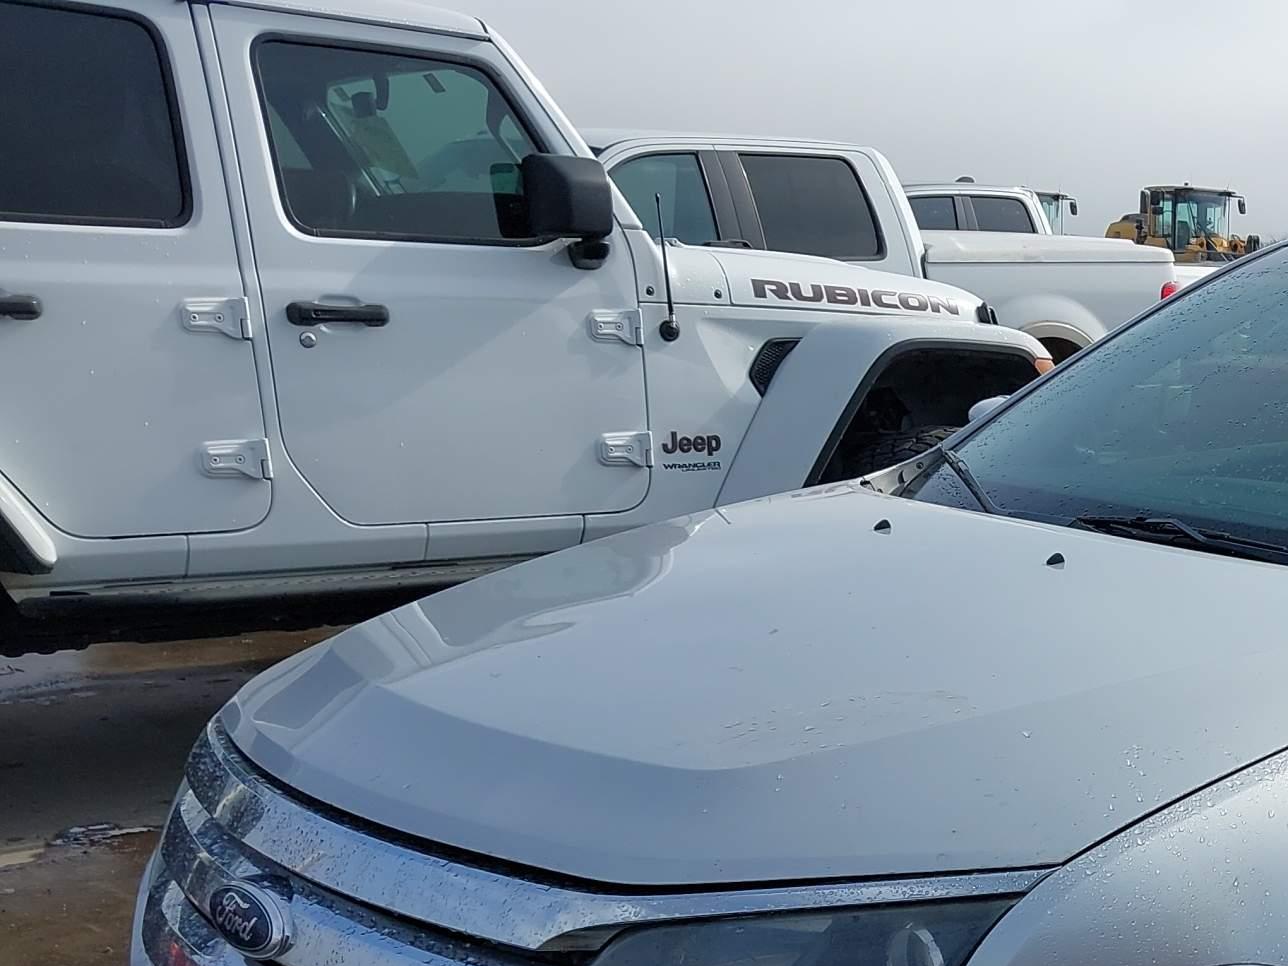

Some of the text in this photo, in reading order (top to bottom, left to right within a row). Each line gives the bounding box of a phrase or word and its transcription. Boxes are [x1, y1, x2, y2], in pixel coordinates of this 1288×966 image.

[751, 278, 959, 315] RUBICON
[662, 431, 721, 456] Jeep
[663, 461, 720, 469] WRANGLER
[215, 892, 258, 941] Ford
